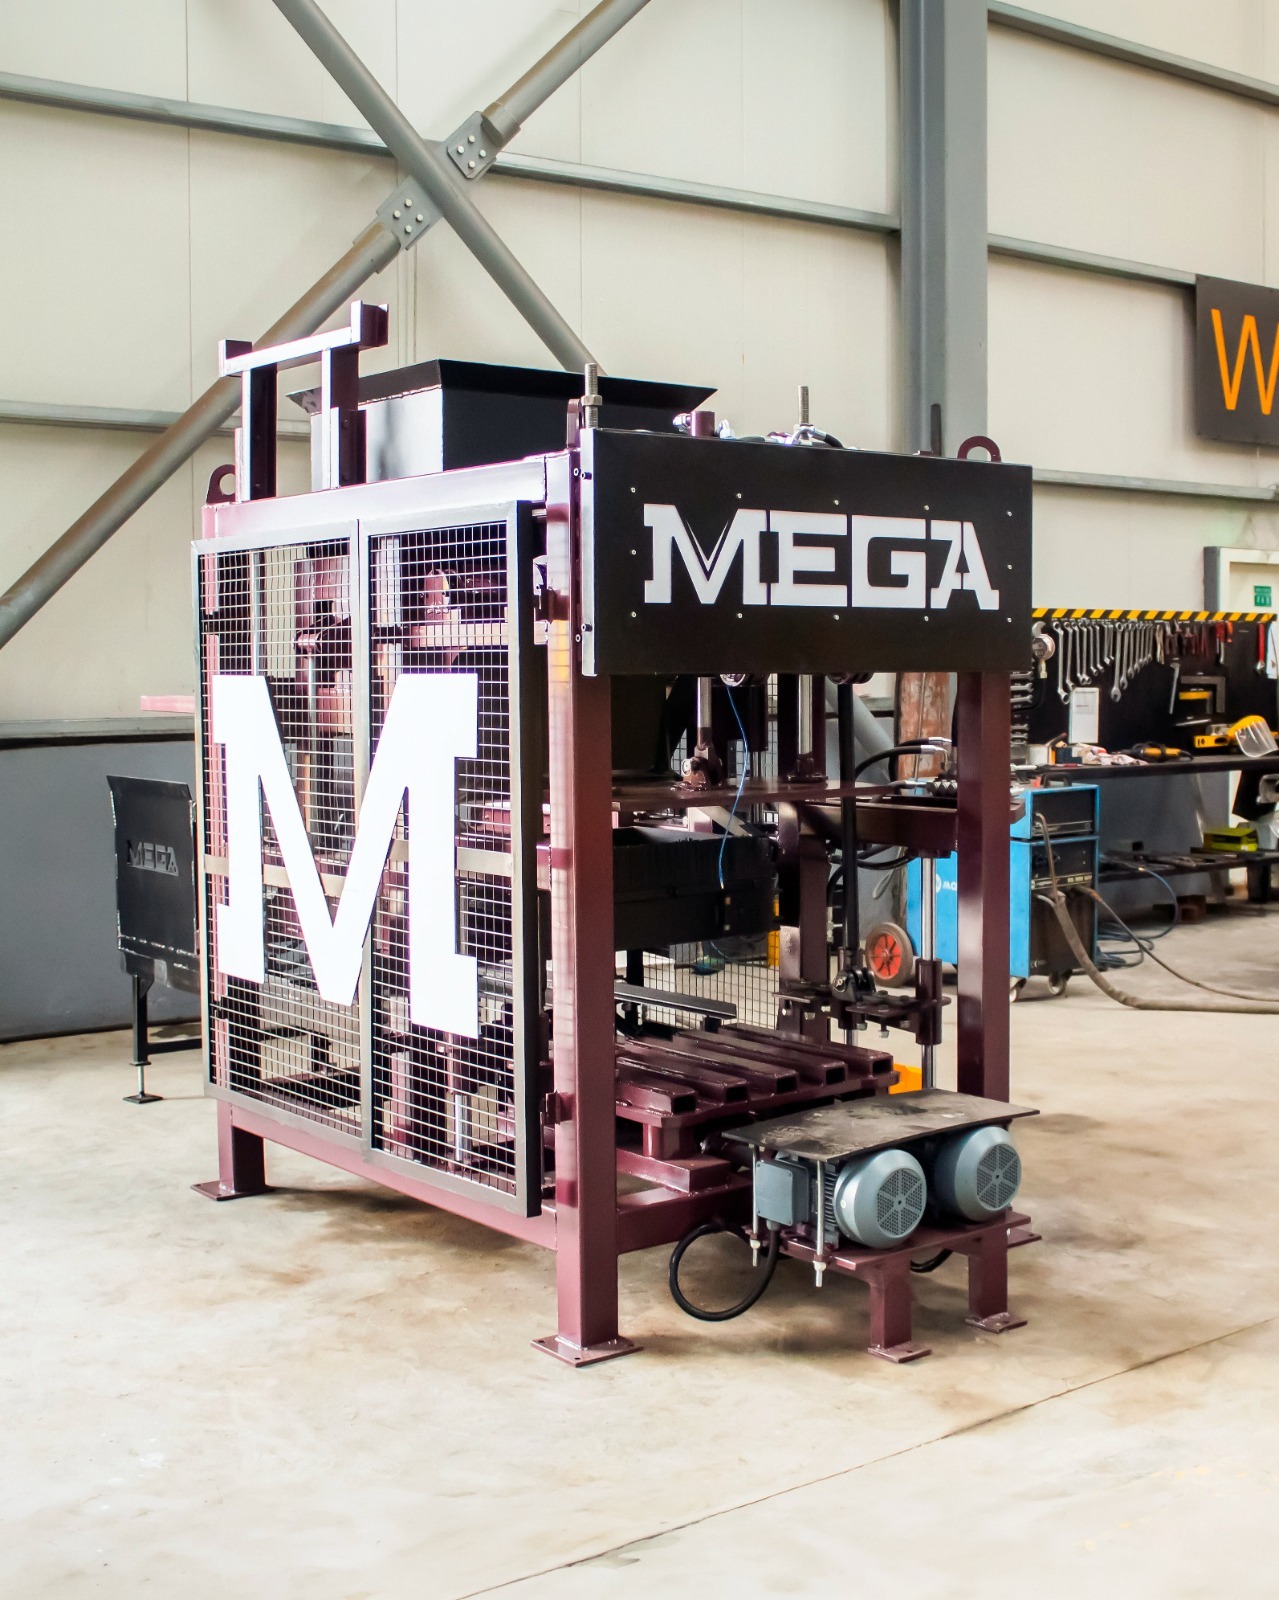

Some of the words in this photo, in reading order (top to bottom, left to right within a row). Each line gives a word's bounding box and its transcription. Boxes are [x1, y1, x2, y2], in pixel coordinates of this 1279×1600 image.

[643, 503, 1000, 610] MEGA
[126, 839, 179, 876] MEGA
[212, 673, 478, 1039] M
